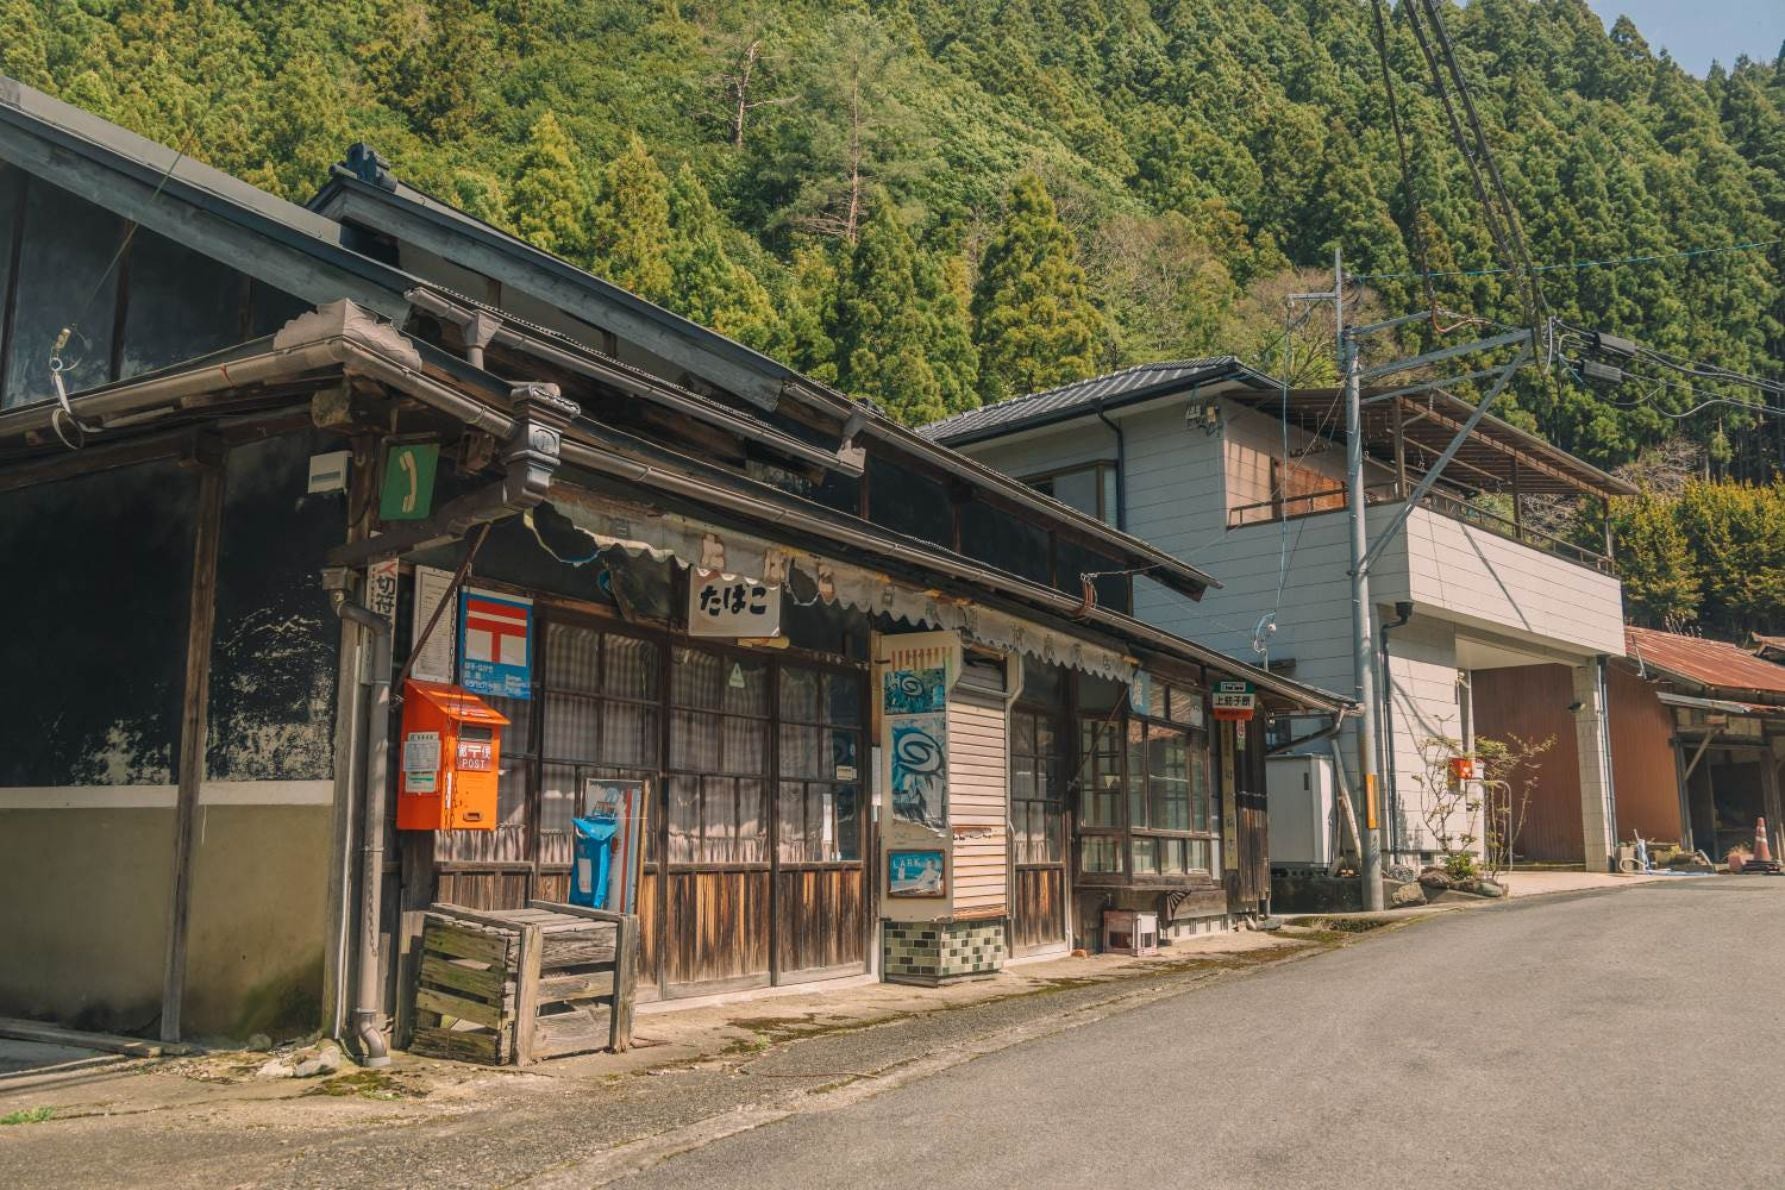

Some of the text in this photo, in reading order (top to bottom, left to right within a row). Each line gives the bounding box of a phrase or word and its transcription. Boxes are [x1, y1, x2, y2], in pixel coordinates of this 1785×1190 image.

[700, 583, 767, 617] たばこ
[462, 759, 485, 769] POST
